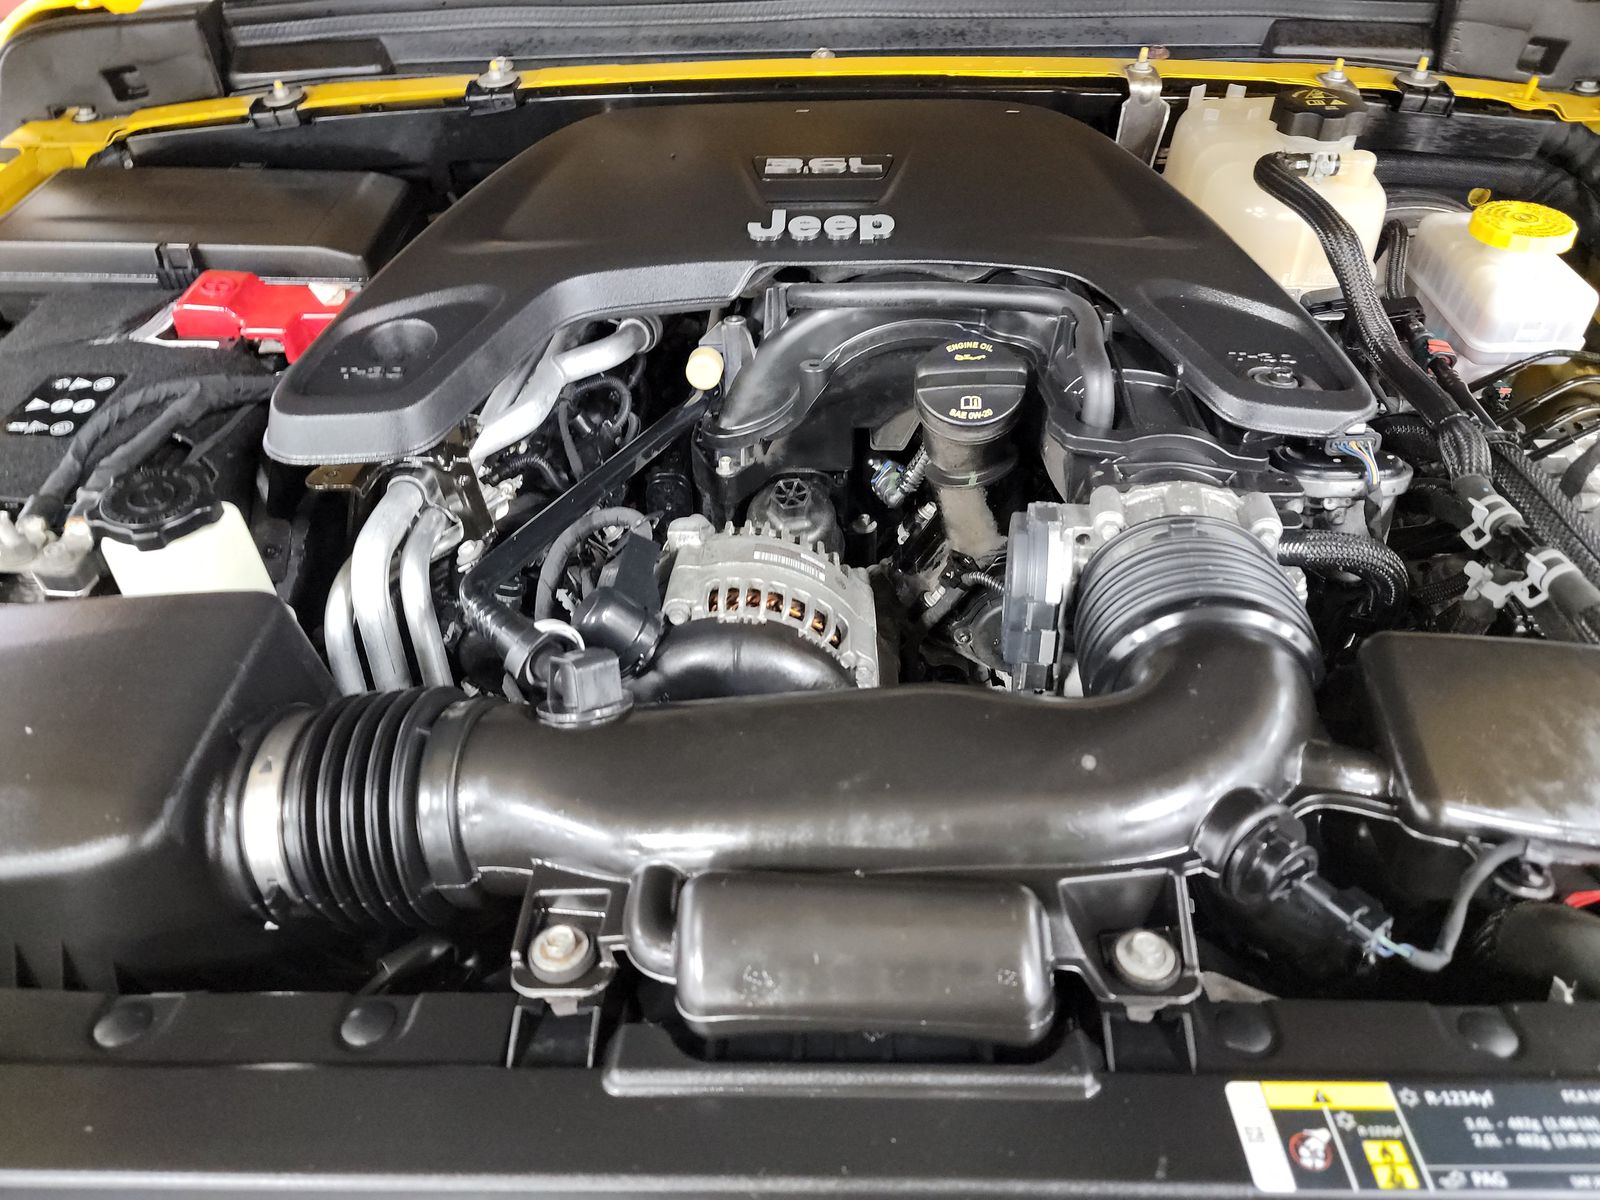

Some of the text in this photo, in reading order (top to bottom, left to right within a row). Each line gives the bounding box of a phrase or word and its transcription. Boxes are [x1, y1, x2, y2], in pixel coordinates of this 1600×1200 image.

[747, 208, 896, 244] Jeep
[946, 341, 993, 352] ENGINE OIL
[949, 408, 967, 419] SAE
